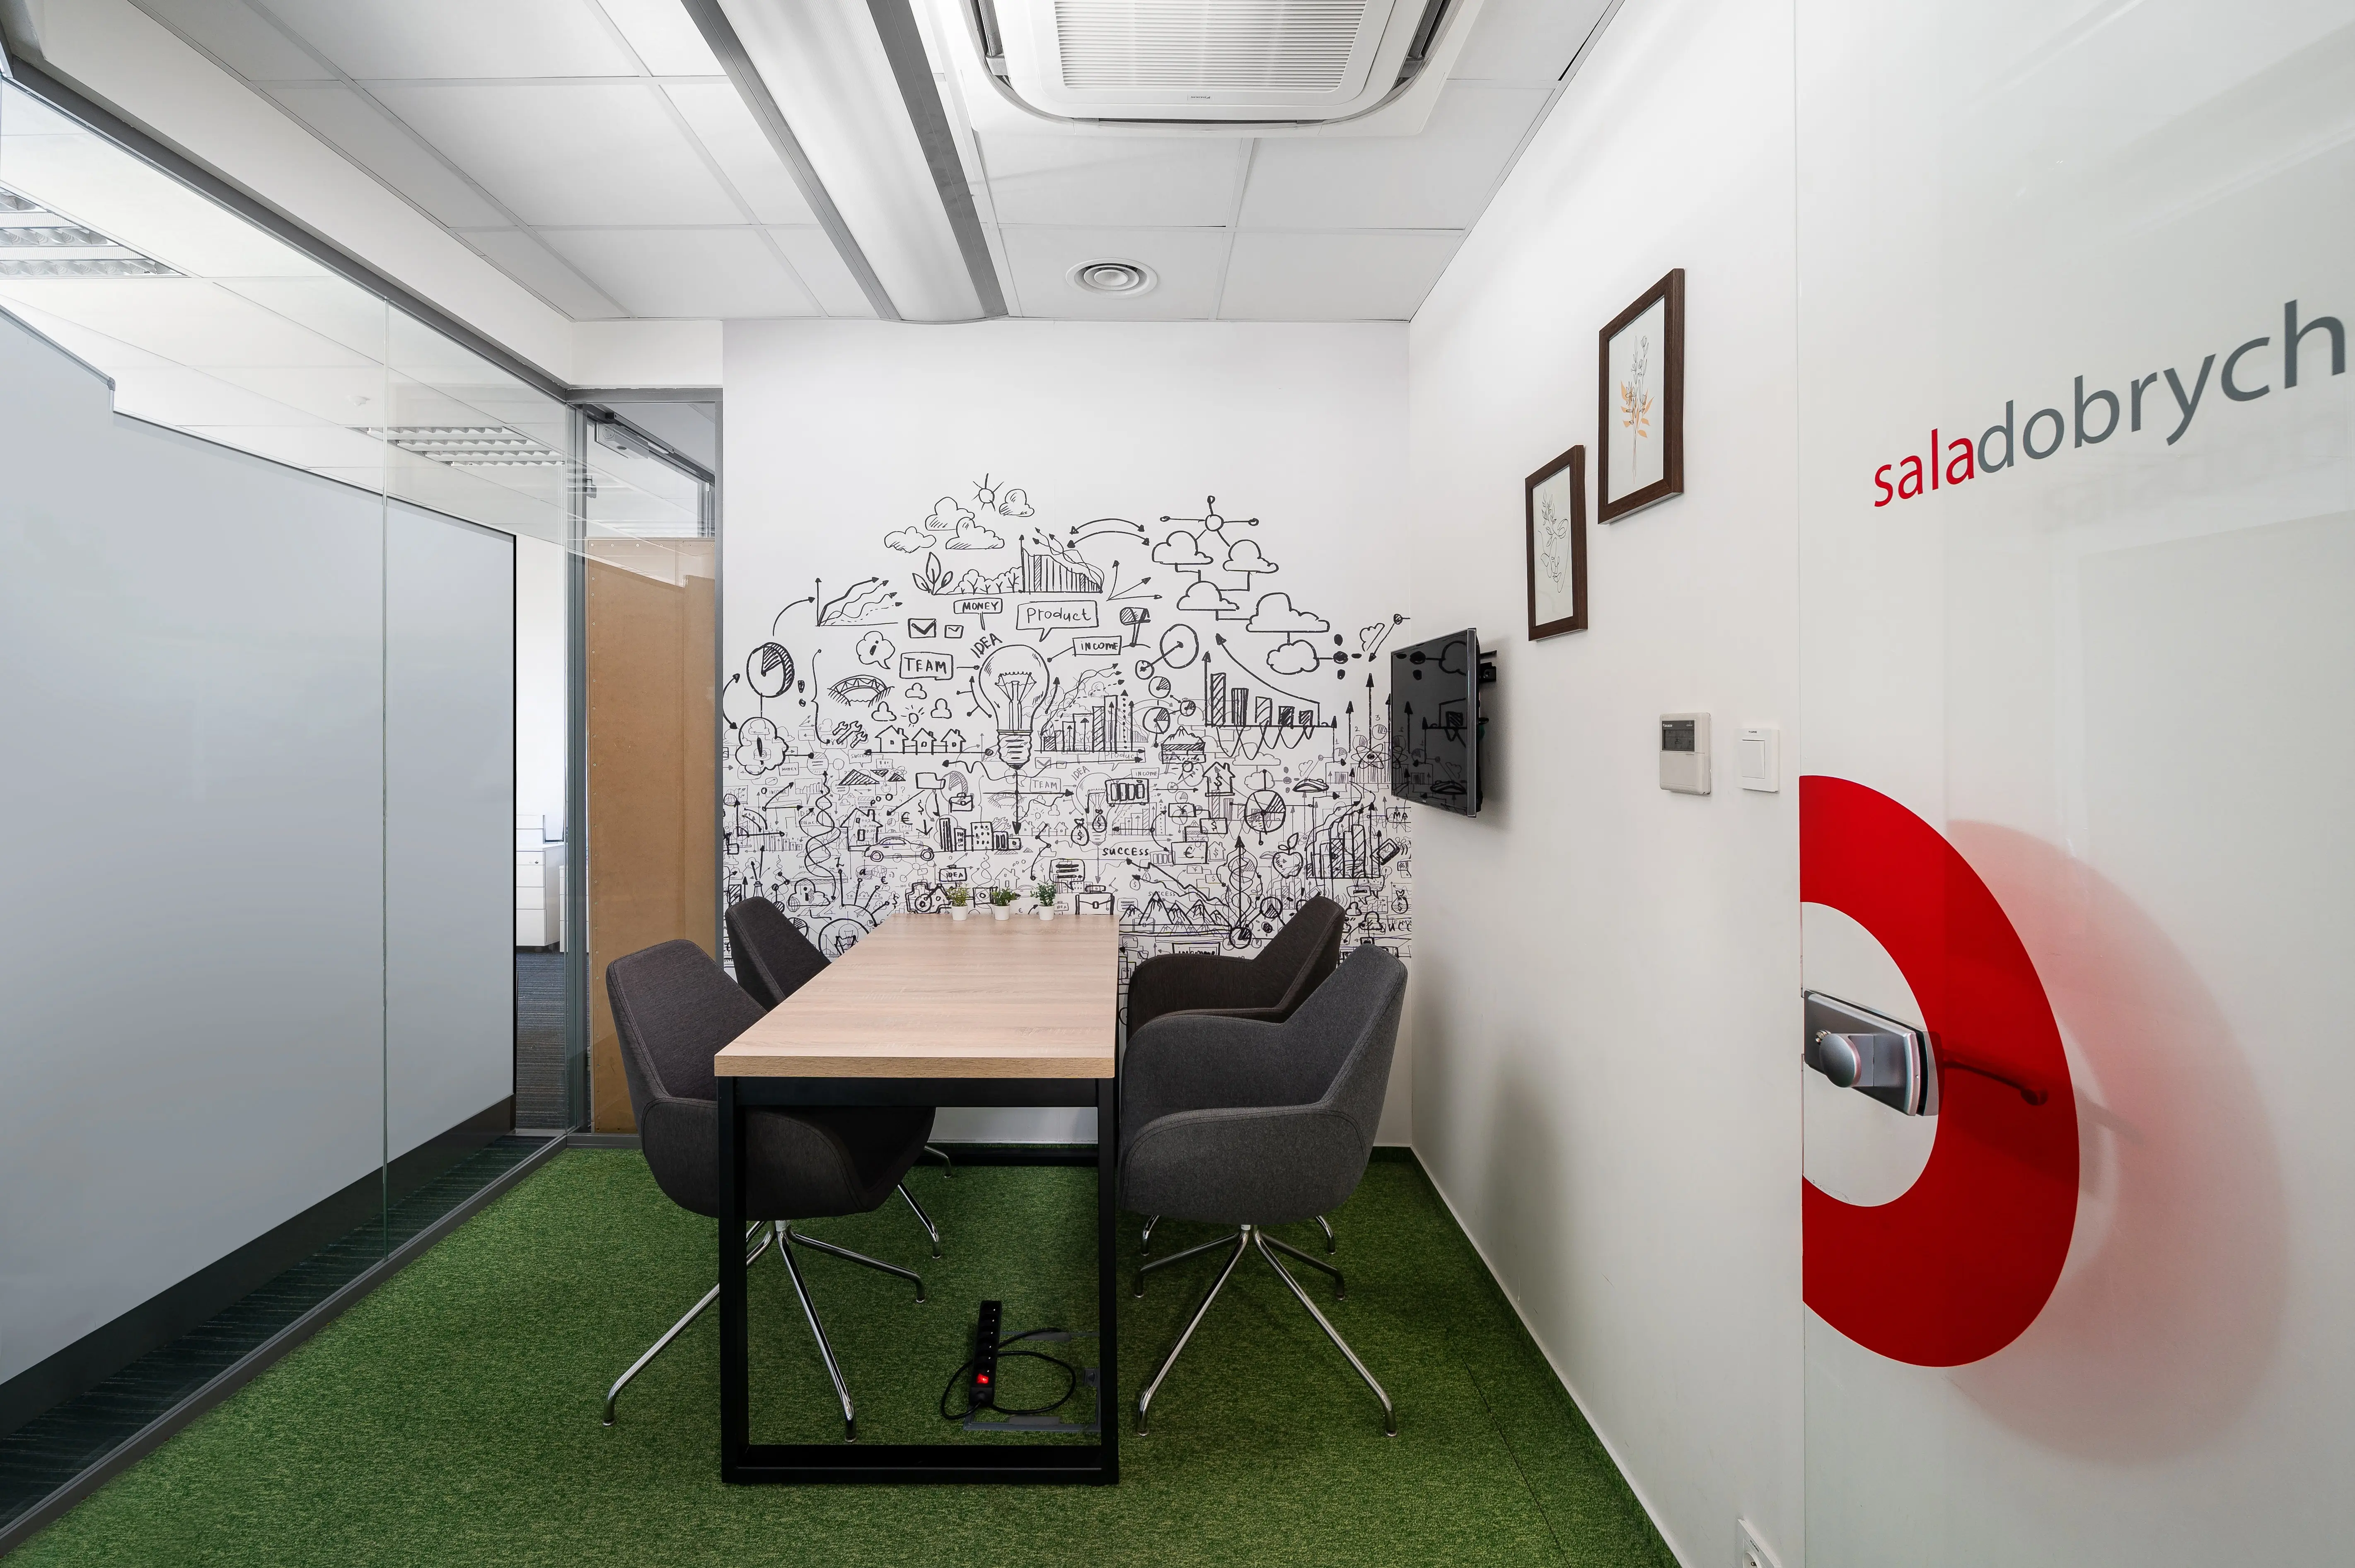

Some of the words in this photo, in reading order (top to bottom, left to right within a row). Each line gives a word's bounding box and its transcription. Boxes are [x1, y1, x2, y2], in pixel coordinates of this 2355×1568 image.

[1874, 299, 2346, 508] saladobrych
[962, 602, 999, 611] MONEY
[1027, 607, 1091, 623] Product
[970, 633, 1003, 657] IDEA
[907, 657, 947, 673] TEAM
[1071, 766, 1090, 780] IDEA
[1032, 780, 1057, 790] TEAM
[1102, 847, 1149, 855] SUCCESS
